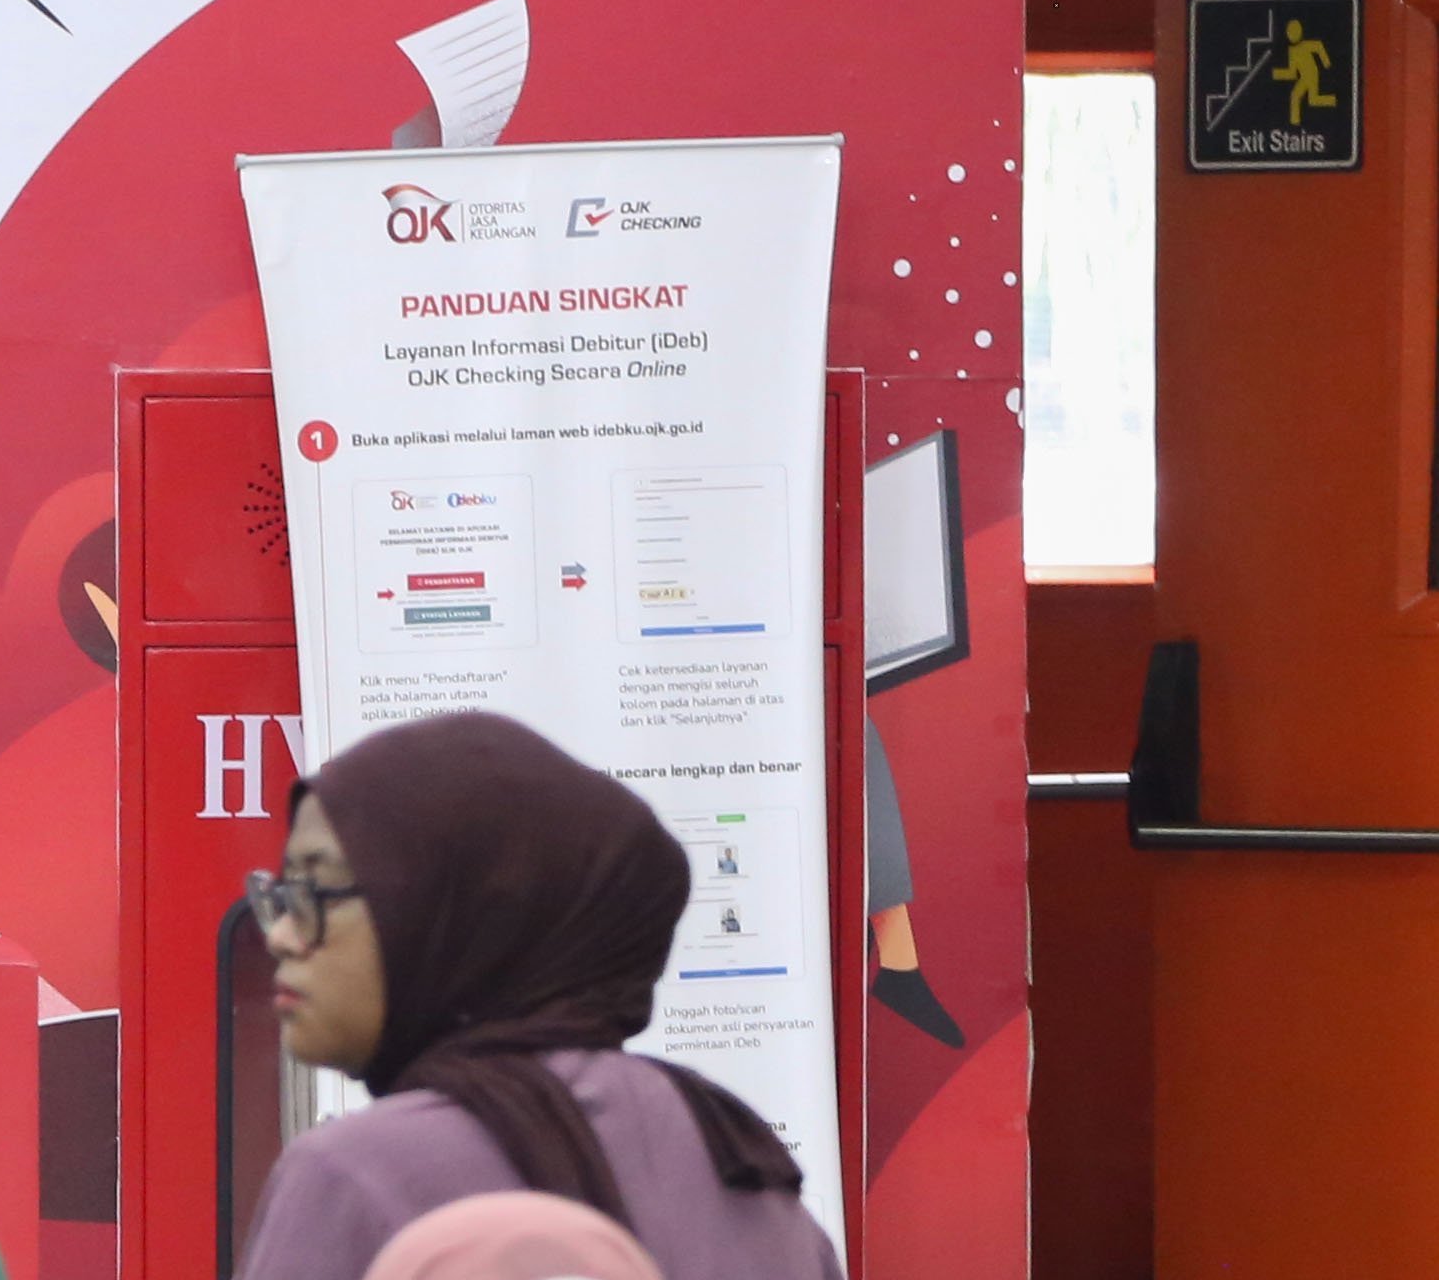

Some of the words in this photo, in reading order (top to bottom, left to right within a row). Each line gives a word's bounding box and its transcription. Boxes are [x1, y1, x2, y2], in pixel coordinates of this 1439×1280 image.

[1228, 129, 1264, 153] Exit
[1269, 129, 1325, 153] Stairs
[469, 201, 525, 215] OTORITAS
[620, 201, 651, 214] OJK
[385, 200, 457, 244] OJK
[470, 215, 498, 227] JASA
[621, 216, 702, 231] CHECKING
[470, 226, 536, 240] KEUANGAN
[401, 290, 550, 318] PANDUAN
[559, 284, 689, 312] SINGKAT
[385, 343, 465, 363] Layanan
[472, 335, 565, 357] Informasi
[571, 333, 646, 353] Debitur
[651, 331, 708, 353] (iDeb)
[408, 368, 450, 387] OJK
[455, 363, 546, 386] Checking
[551, 362, 621, 382] Secara
[627, 360, 687, 378] Online
[310, 431, 323, 450] 1
[352, 433, 390, 448] Buka
[394, 429, 451, 447] aplikasi
[454, 429, 507, 444] melalui
[510, 427, 555, 441] laman
[559, 424, 589, 439] web
[593, 420, 704, 441] idebku.ojk.go.id
[618, 665, 641, 677] Cek
[645, 663, 719, 675] ketersediaan
[722, 661, 768, 673] layanan
[360, 675, 382, 687] Klik
[385, 676, 419, 686] menu
[619, 682, 664, 695] dengan
[667, 680, 712, 692] mengisi
[715, 678, 758, 689] seluruh
[360, 691, 390, 704] pada
[394, 690, 447, 702] halaman
[450, 688, 488, 700] utama
[620, 699, 657, 711] kolom
[660, 697, 689, 710] pada
[692, 695, 741, 707] halaman
[745, 694, 756, 705] di
[759, 694, 784, 704] atas
[362, 707, 407, 721] aplikasi
[620, 716, 643, 728] dan
[647, 714, 667, 725] klik
[616, 767, 667, 778] secara
[670, 763, 725, 780] lengkap
[729, 763, 755, 774] dan
[759, 761, 802, 773] benar
[664, 1006, 710, 1019] Unggah
[664, 1024, 718, 1035] dokumen
[721, 1022, 742, 1033] asli
[743, 1019, 814, 1033] persyaratan
[665, 1039, 731, 1053] permintaan
[733, 1037, 761, 1049] iDeb
